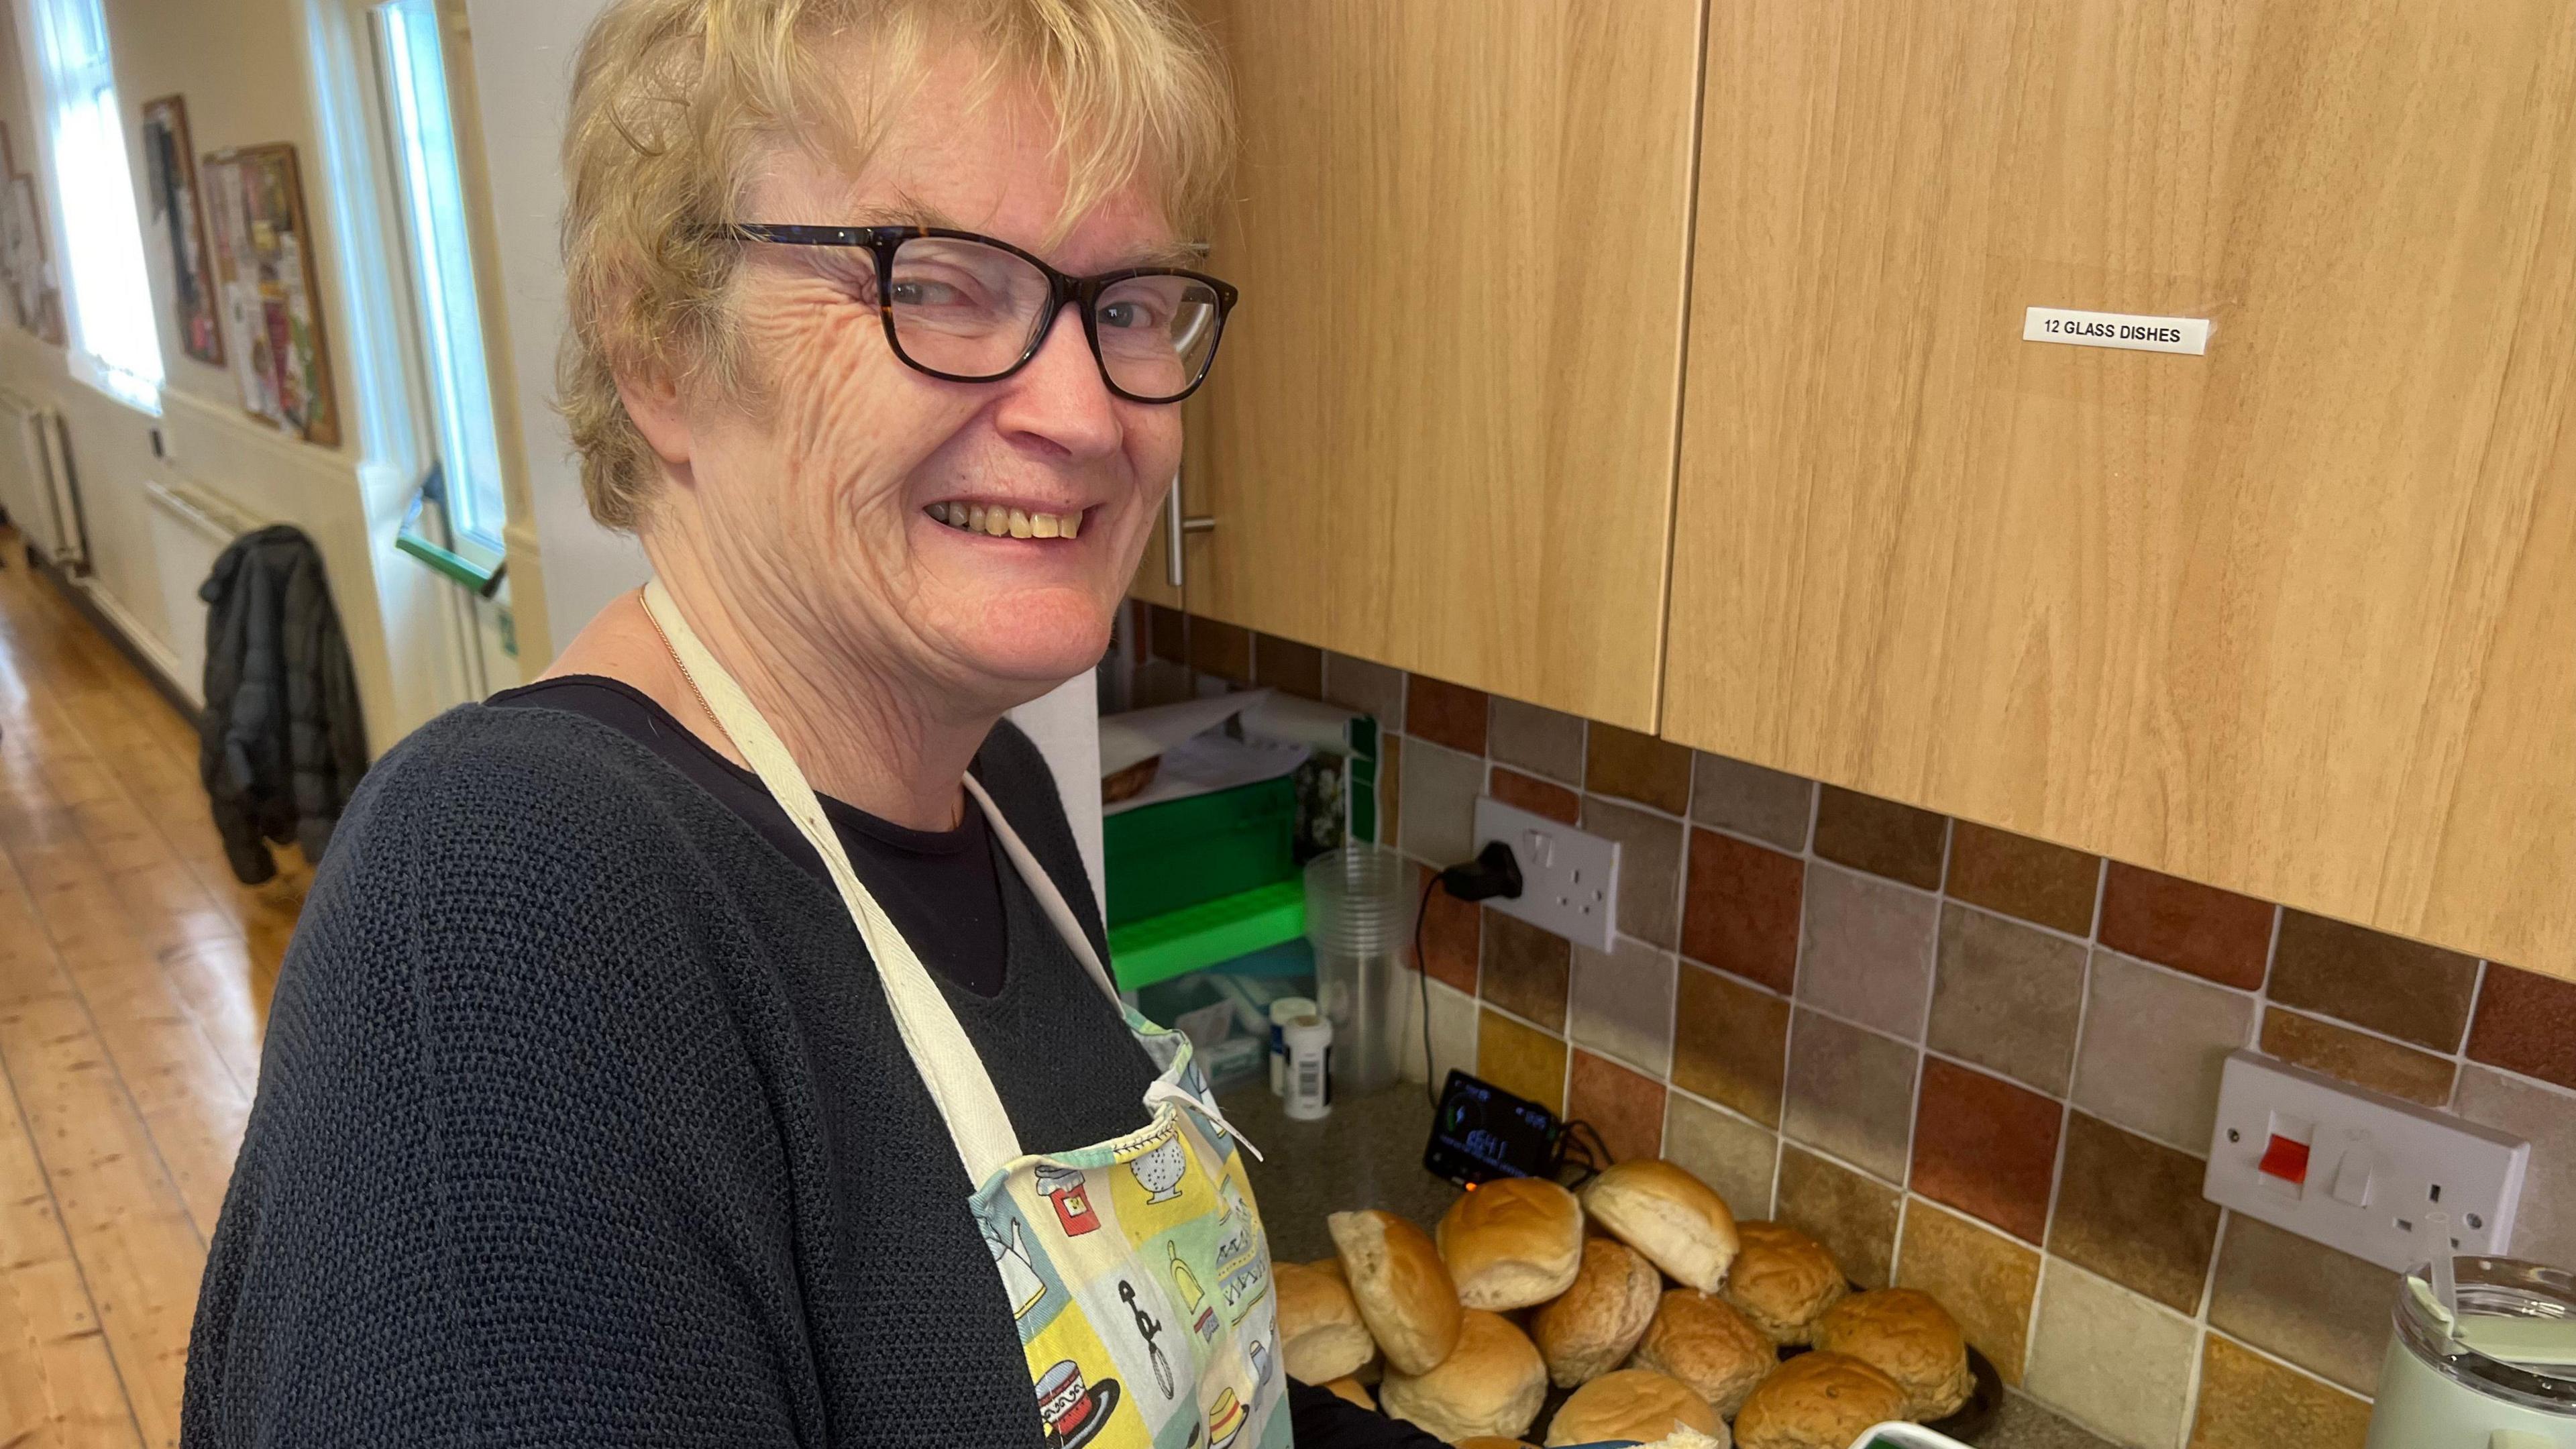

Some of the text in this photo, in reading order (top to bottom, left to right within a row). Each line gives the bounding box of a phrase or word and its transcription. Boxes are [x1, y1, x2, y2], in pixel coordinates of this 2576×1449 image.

[2045, 319, 2181, 343] 12 GLASS DISHES
